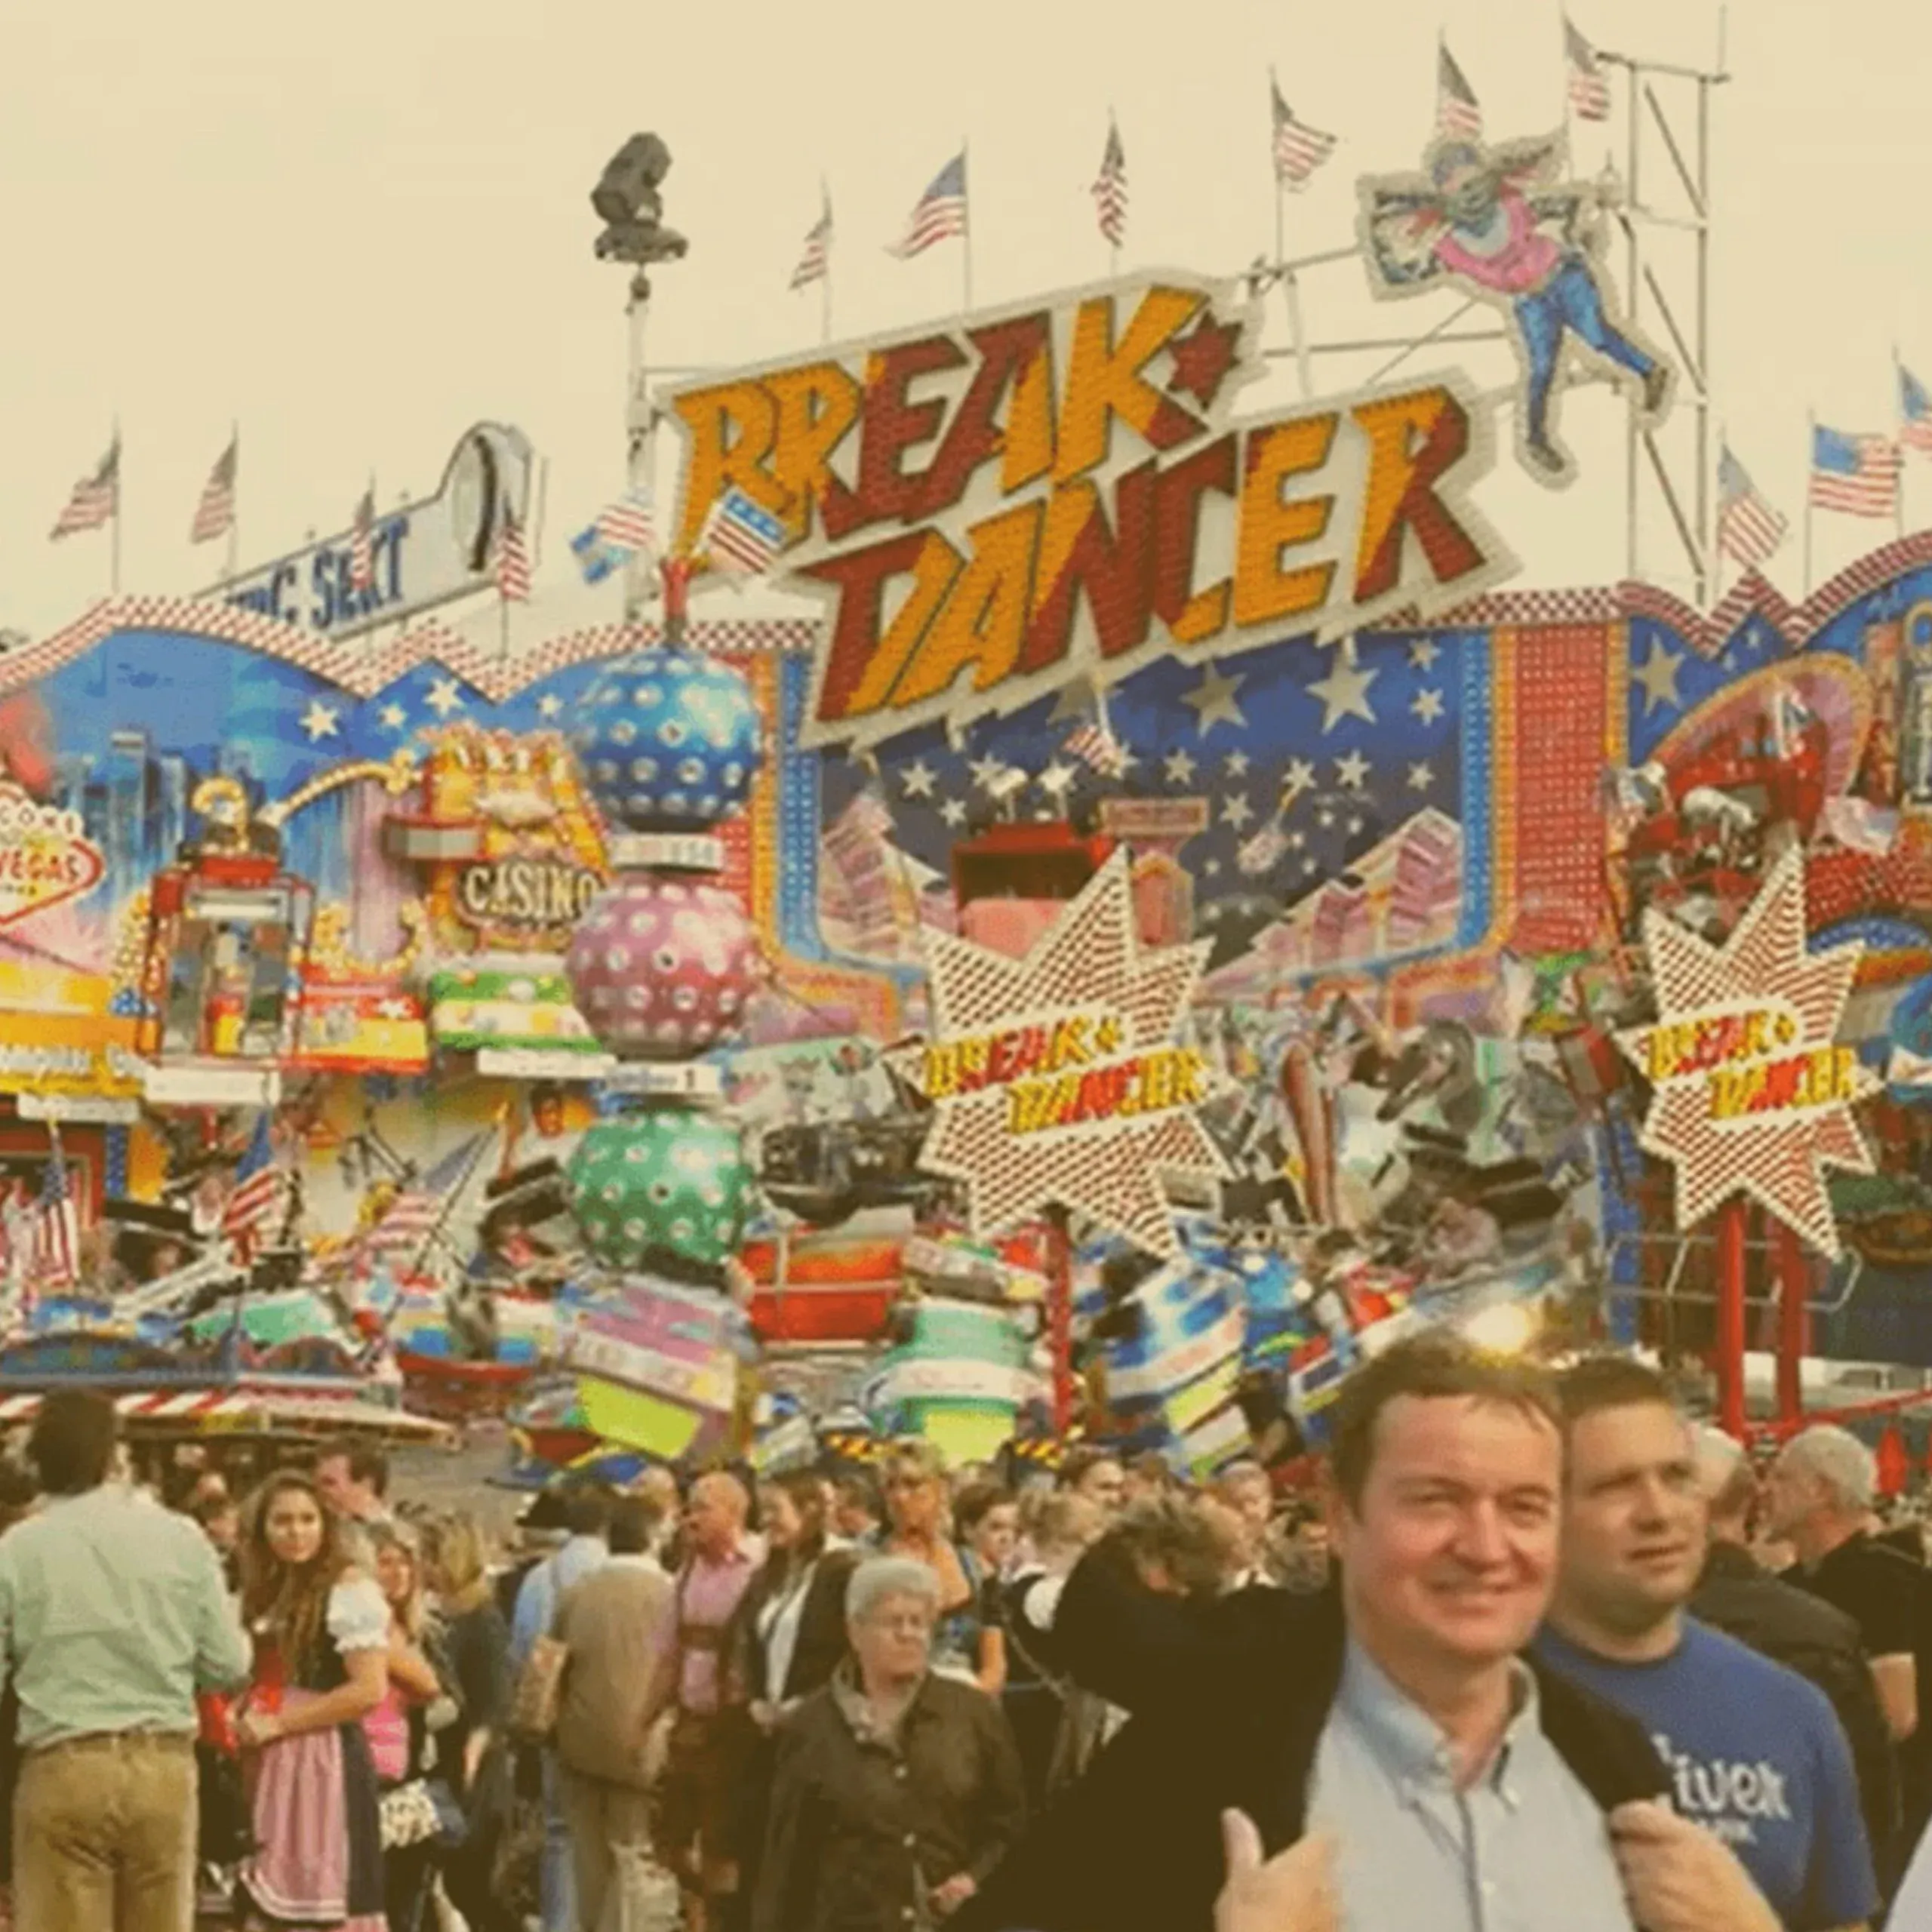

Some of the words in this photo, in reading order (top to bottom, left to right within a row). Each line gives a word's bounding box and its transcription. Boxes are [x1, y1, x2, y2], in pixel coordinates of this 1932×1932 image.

[672, 284, 1212, 571] BREAK
[794, 383, 1488, 723] DANCER
[466, 860, 600, 919] CASINO
[926, 1015, 1094, 1099] BREAK
[1008, 1048, 1208, 1134] DANCER
